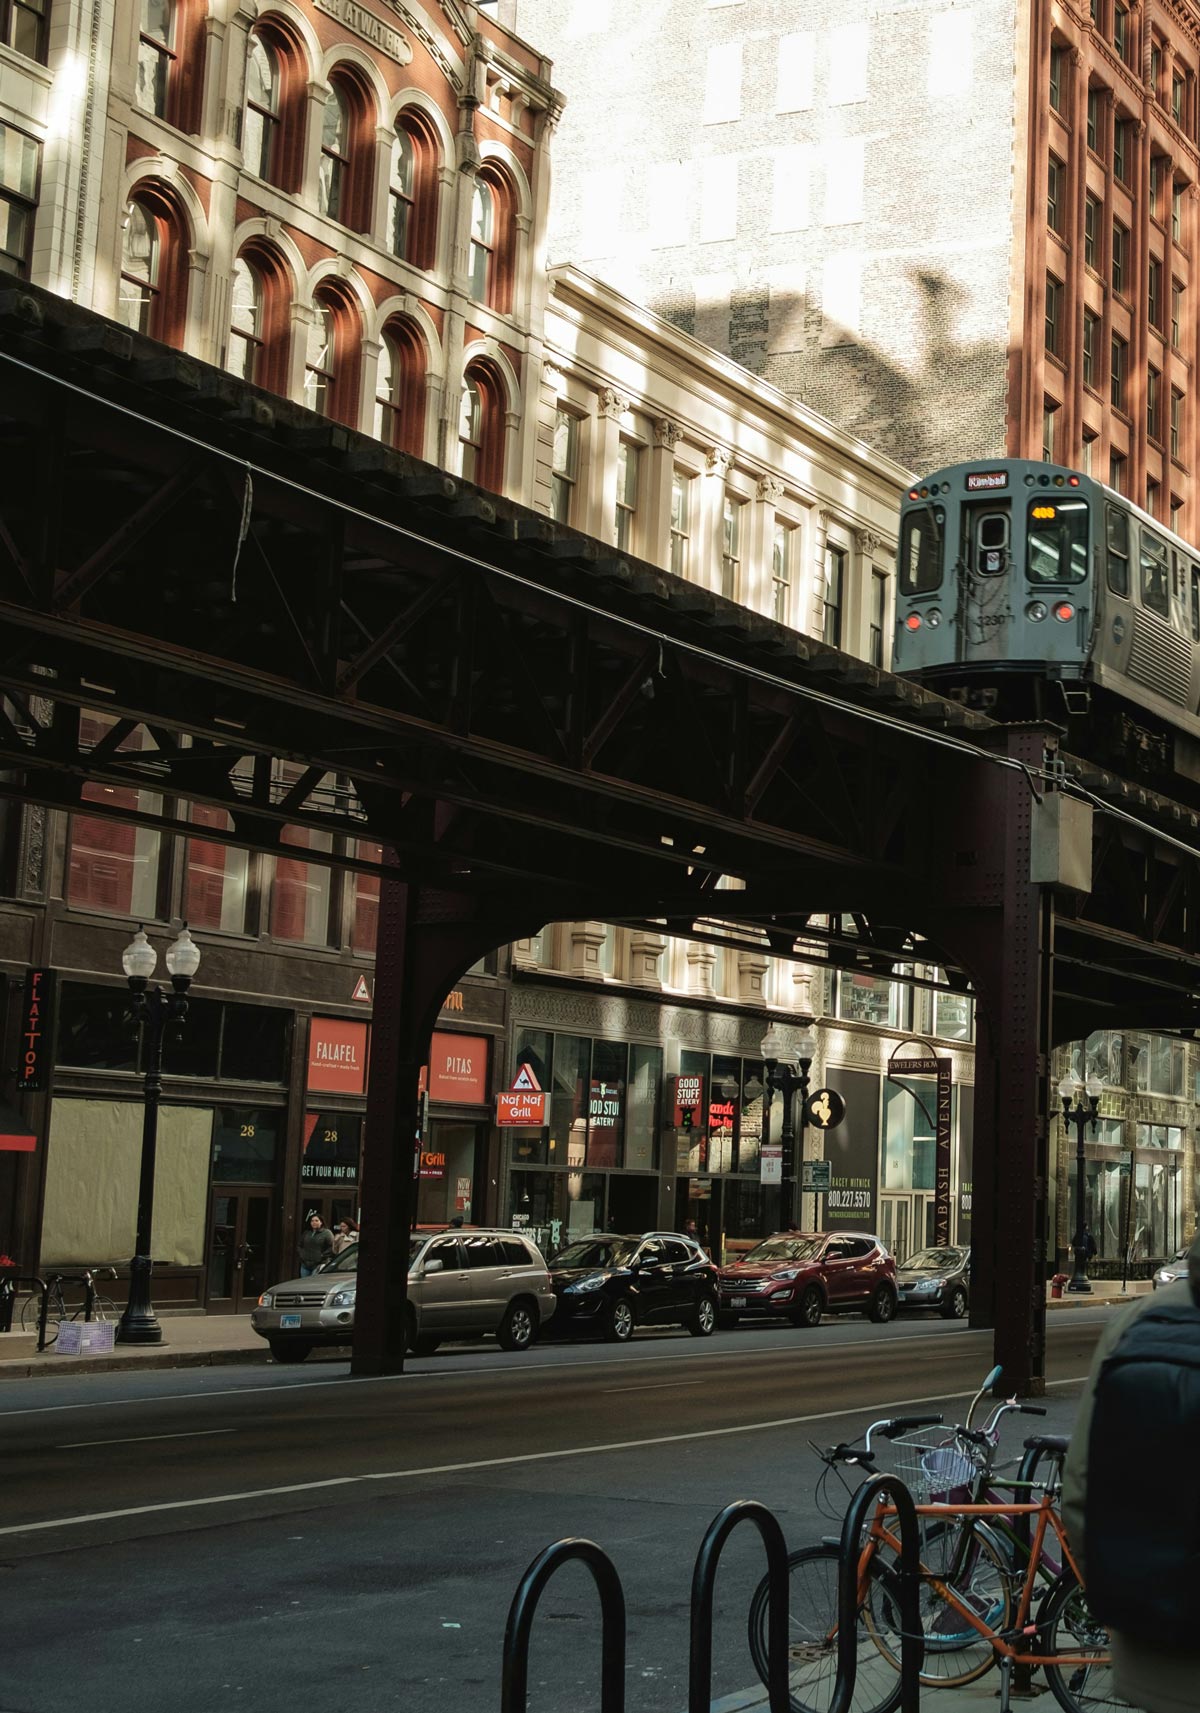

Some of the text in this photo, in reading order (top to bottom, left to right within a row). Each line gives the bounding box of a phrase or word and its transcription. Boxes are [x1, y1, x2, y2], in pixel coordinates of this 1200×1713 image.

[968, 474, 1006, 487] Kimball
[316, 1042, 356, 1063] FALAFEL
[446, 1057, 472, 1074] PITAS
[678, 1078, 699, 1088] GOOD
[677, 1088, 700, 1099] STUFF
[501, 1094, 542, 1107] Naf Naf
[510, 1107, 531, 1118] Grill
[592, 1116, 615, 1127] EATERY
[240, 1125, 255, 1137] 28
[324, 1131, 338, 1142] 28
[426, 1152, 446, 1166] Grill
[937, 1071, 950, 1247] WABASH AVENUE
[302, 1165, 356, 1178] GET YOUR NAF ON
[831, 1177, 848, 1187] RACEY
[828, 1190, 871, 1207] 800.227.5570
